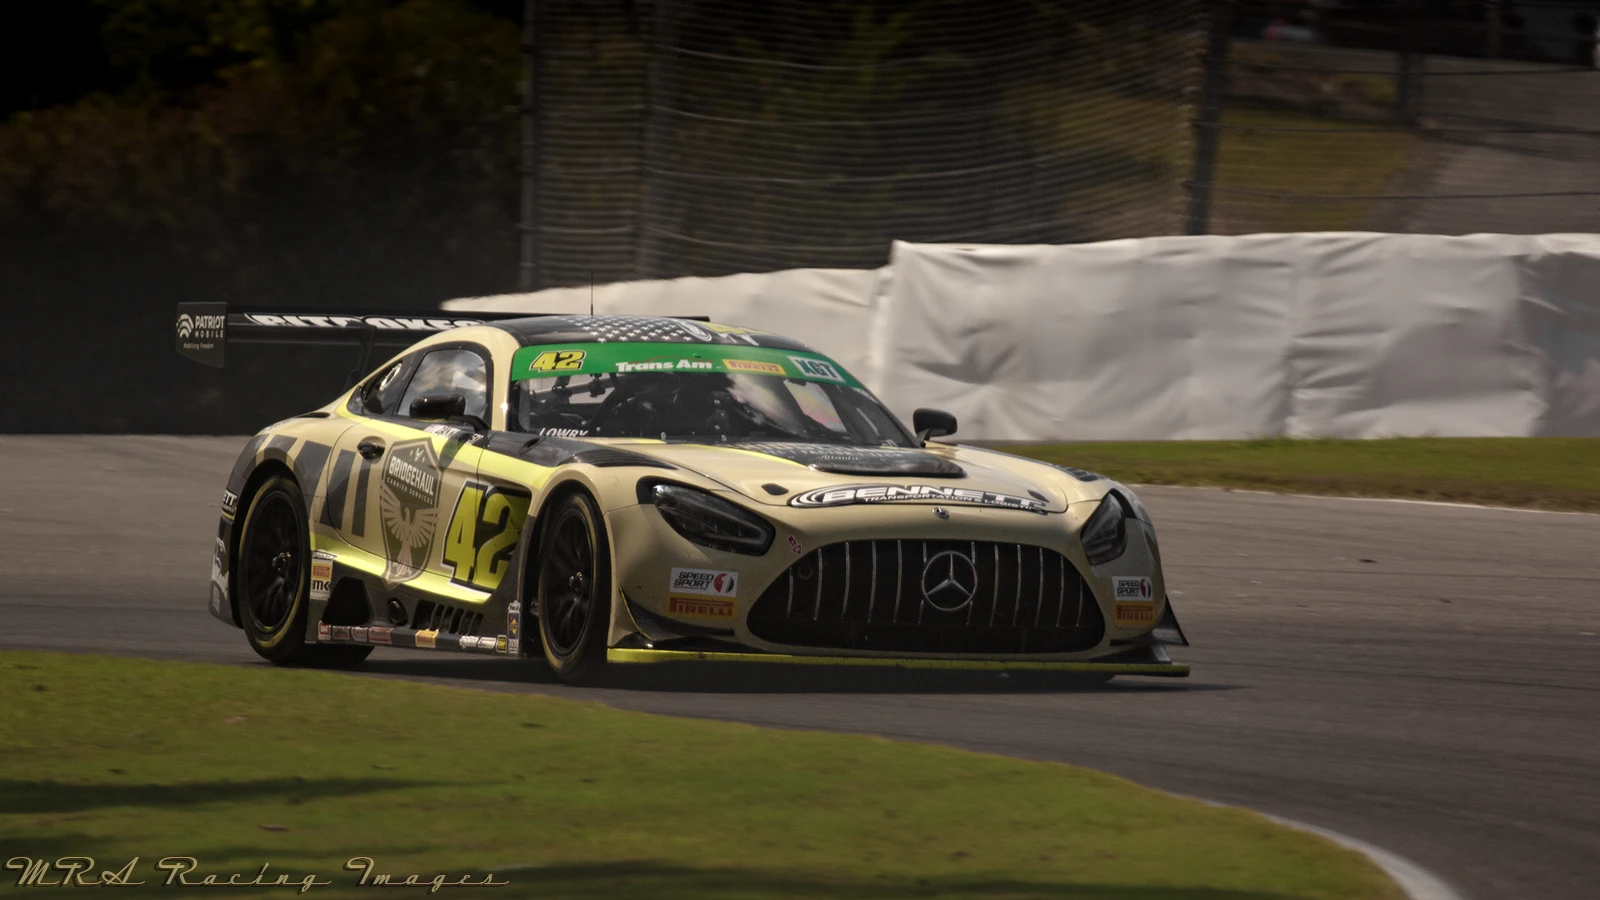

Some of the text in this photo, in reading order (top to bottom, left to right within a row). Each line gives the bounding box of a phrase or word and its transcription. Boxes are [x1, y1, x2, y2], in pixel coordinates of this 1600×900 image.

[195, 315, 225, 329] PATRIOT
[195, 330, 224, 338] MOBILE
[529, 349, 586, 373] 42
[616, 359, 713, 373] Trans Am
[795, 359, 837, 378] XGT
[539, 427, 589, 437] LOWRY
[389, 456, 435, 495] BRIDGEHAUL
[387, 477, 433, 504] CARRIER SERVICES
[821, 486, 1043, 507] BENNETT
[862, 494, 973, 502] TRANSPORTATION
[442, 479, 529, 592] 42
[678, 571, 714, 580] SPEED
[674, 578, 712, 588] SPORT
[1118, 579, 1140, 587] SPEED
[669, 597, 734, 616] PIRELLI
[1116, 605, 1154, 620] PIRELLI
